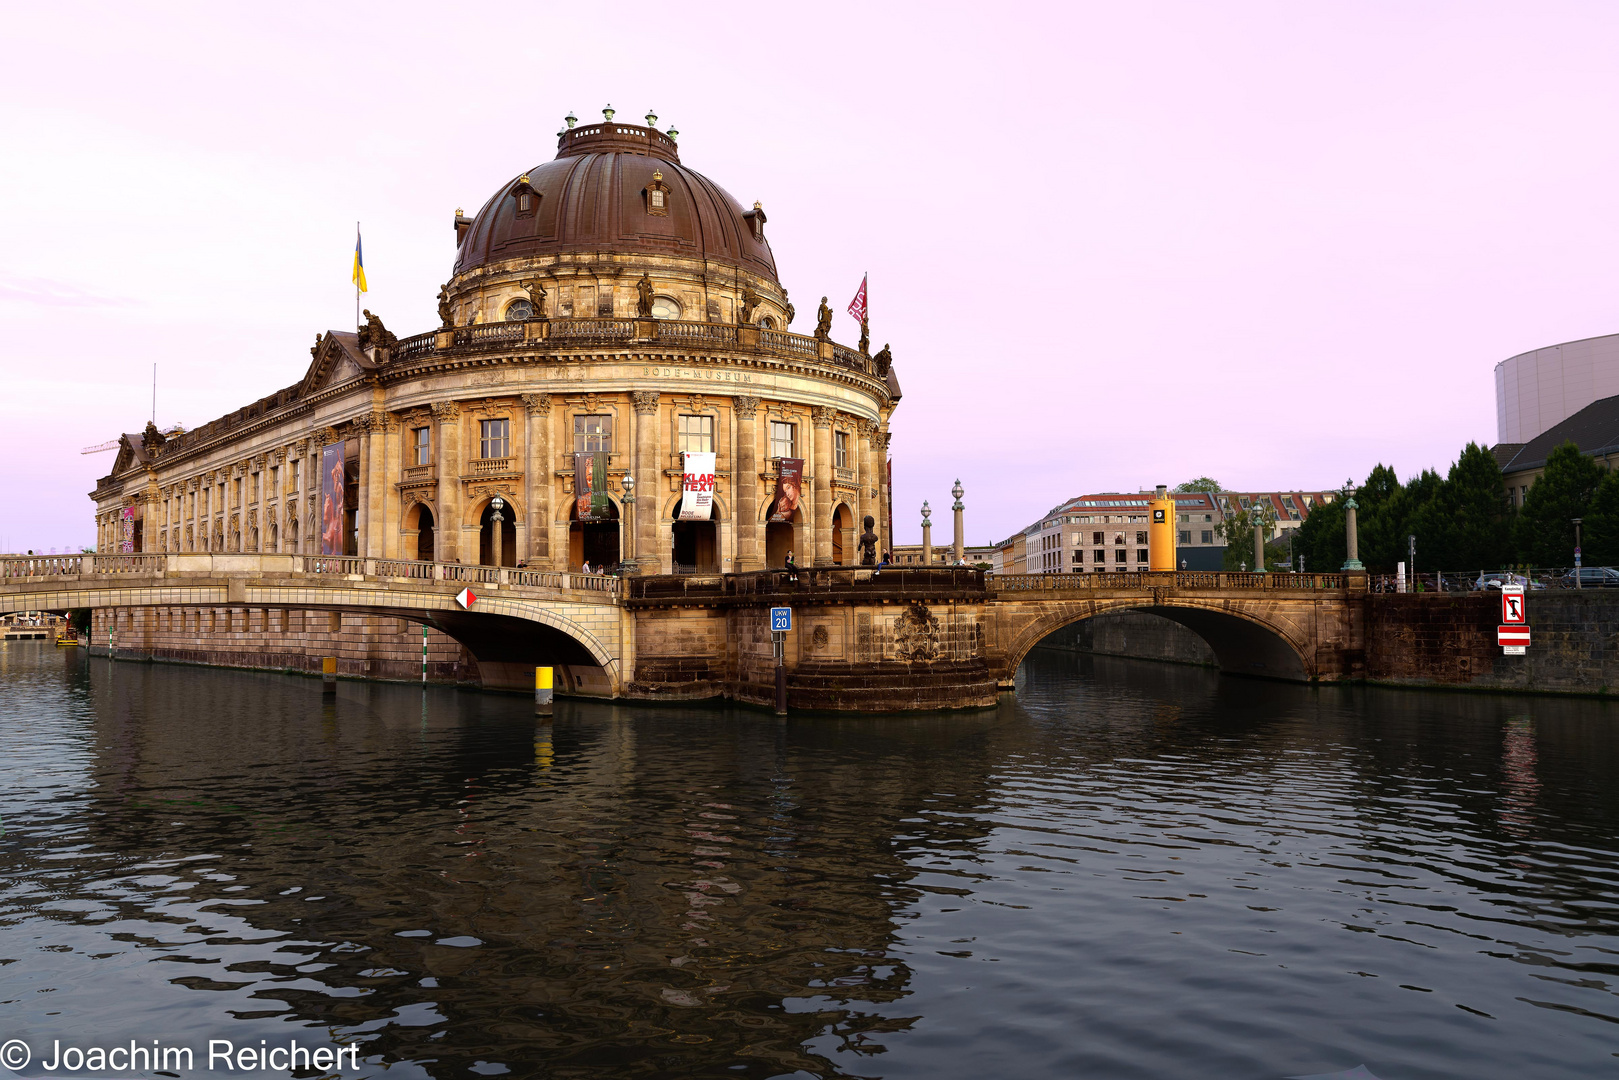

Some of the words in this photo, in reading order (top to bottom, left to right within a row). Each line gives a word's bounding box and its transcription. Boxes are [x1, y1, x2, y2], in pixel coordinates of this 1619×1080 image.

[643, 367, 752, 382] BODE-MUSEUM
[684, 473, 715, 483] KLAR
[684, 482, 714, 492] TEXT
[776, 617, 787, 628] 20
